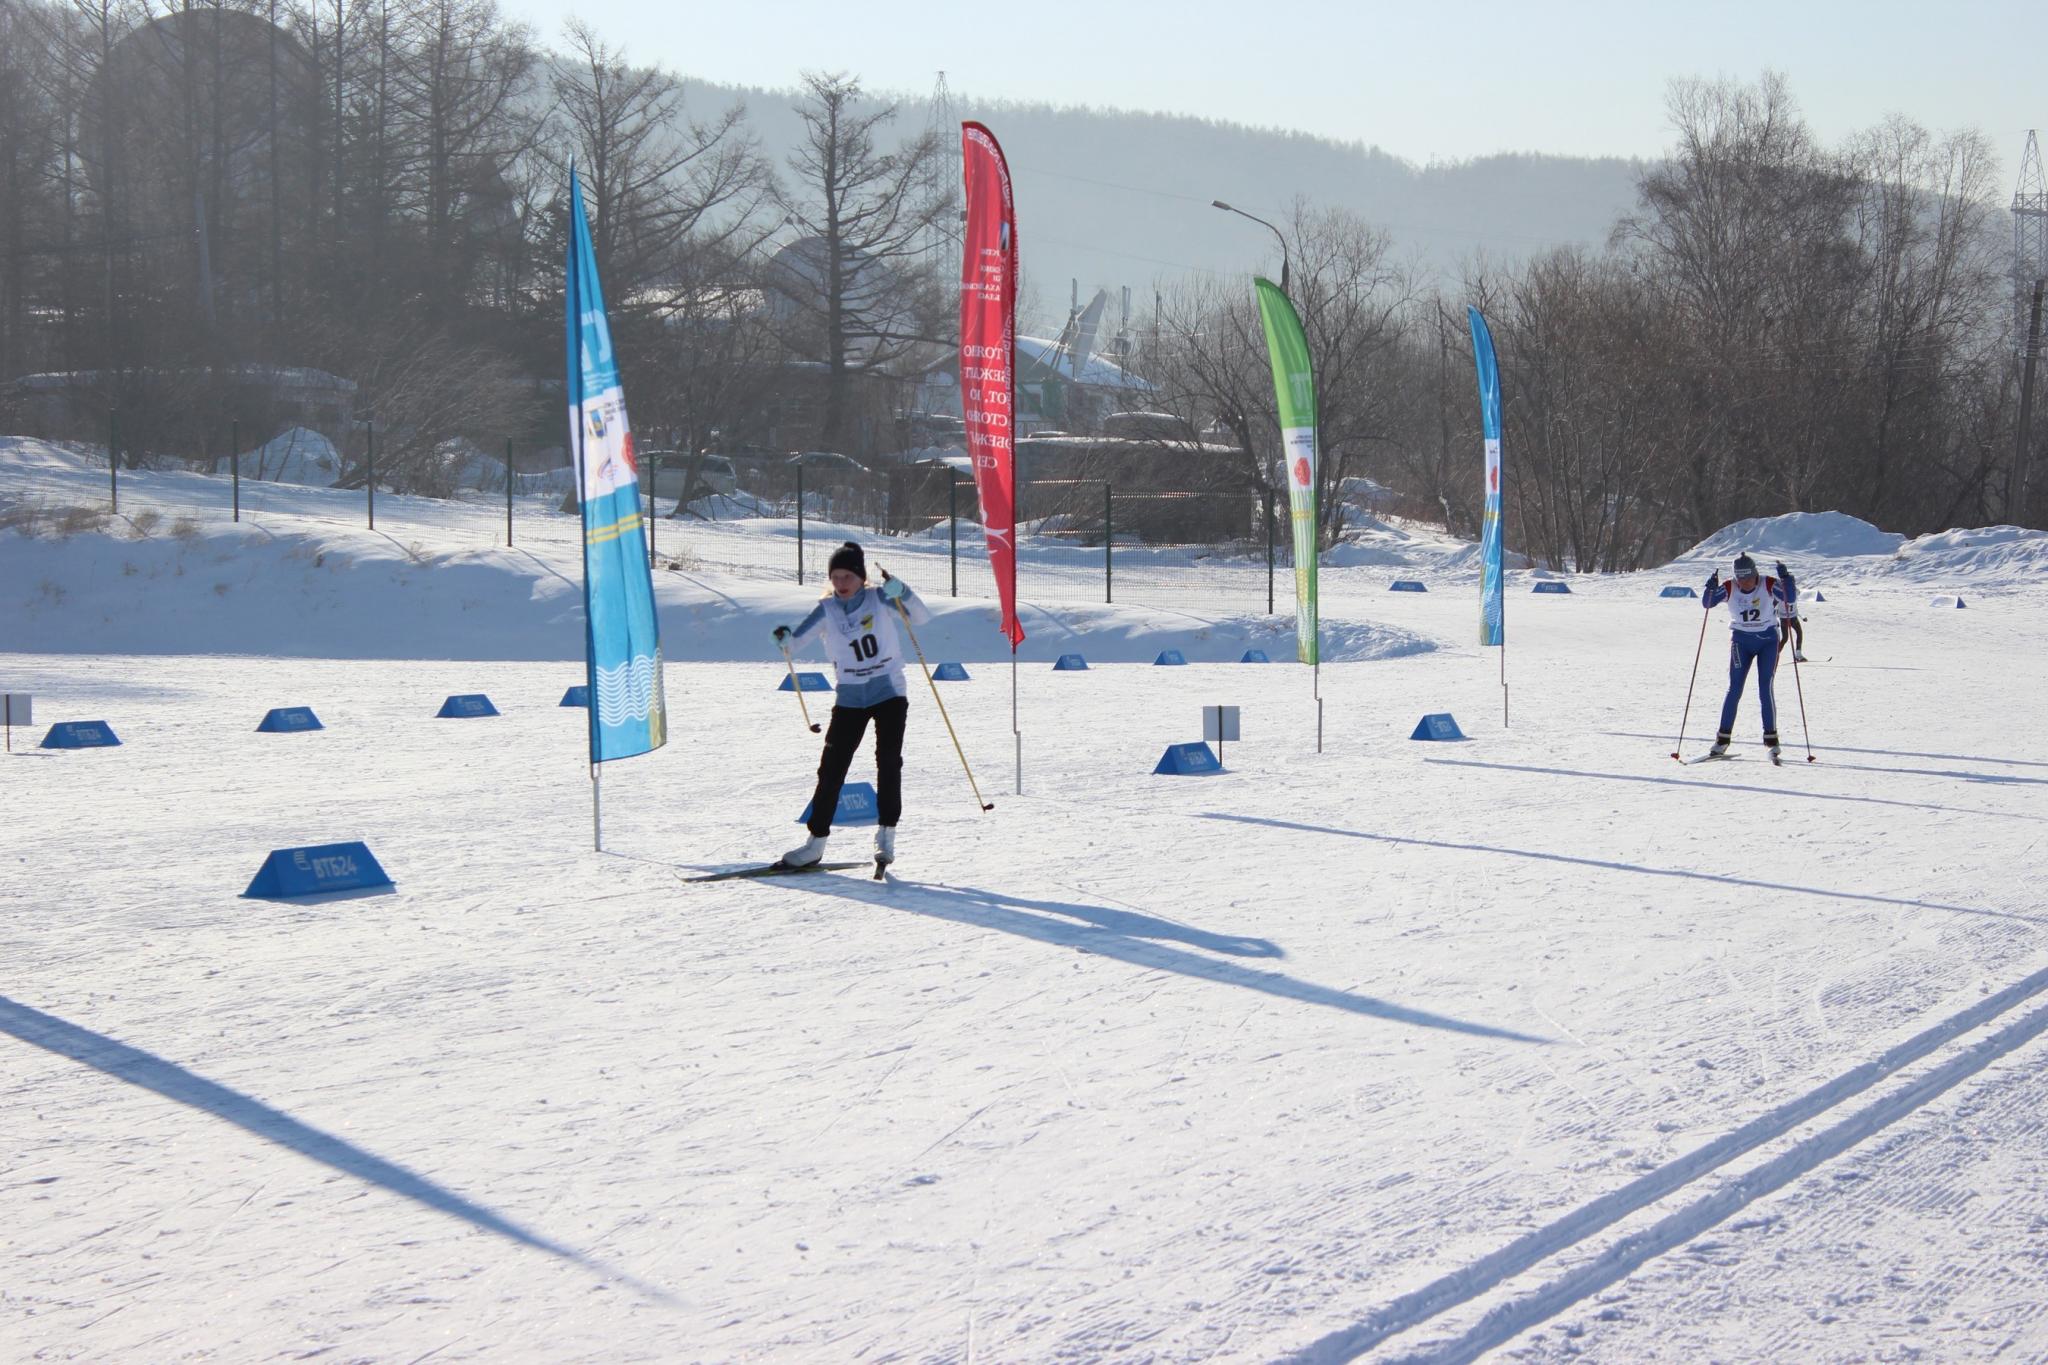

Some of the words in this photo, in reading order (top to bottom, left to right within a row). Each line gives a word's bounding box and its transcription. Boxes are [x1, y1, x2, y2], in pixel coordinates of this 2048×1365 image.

[1740, 609, 1760, 623] 12
[849, 633, 879, 662] 10
[312, 855, 358, 879] ВТБ24
